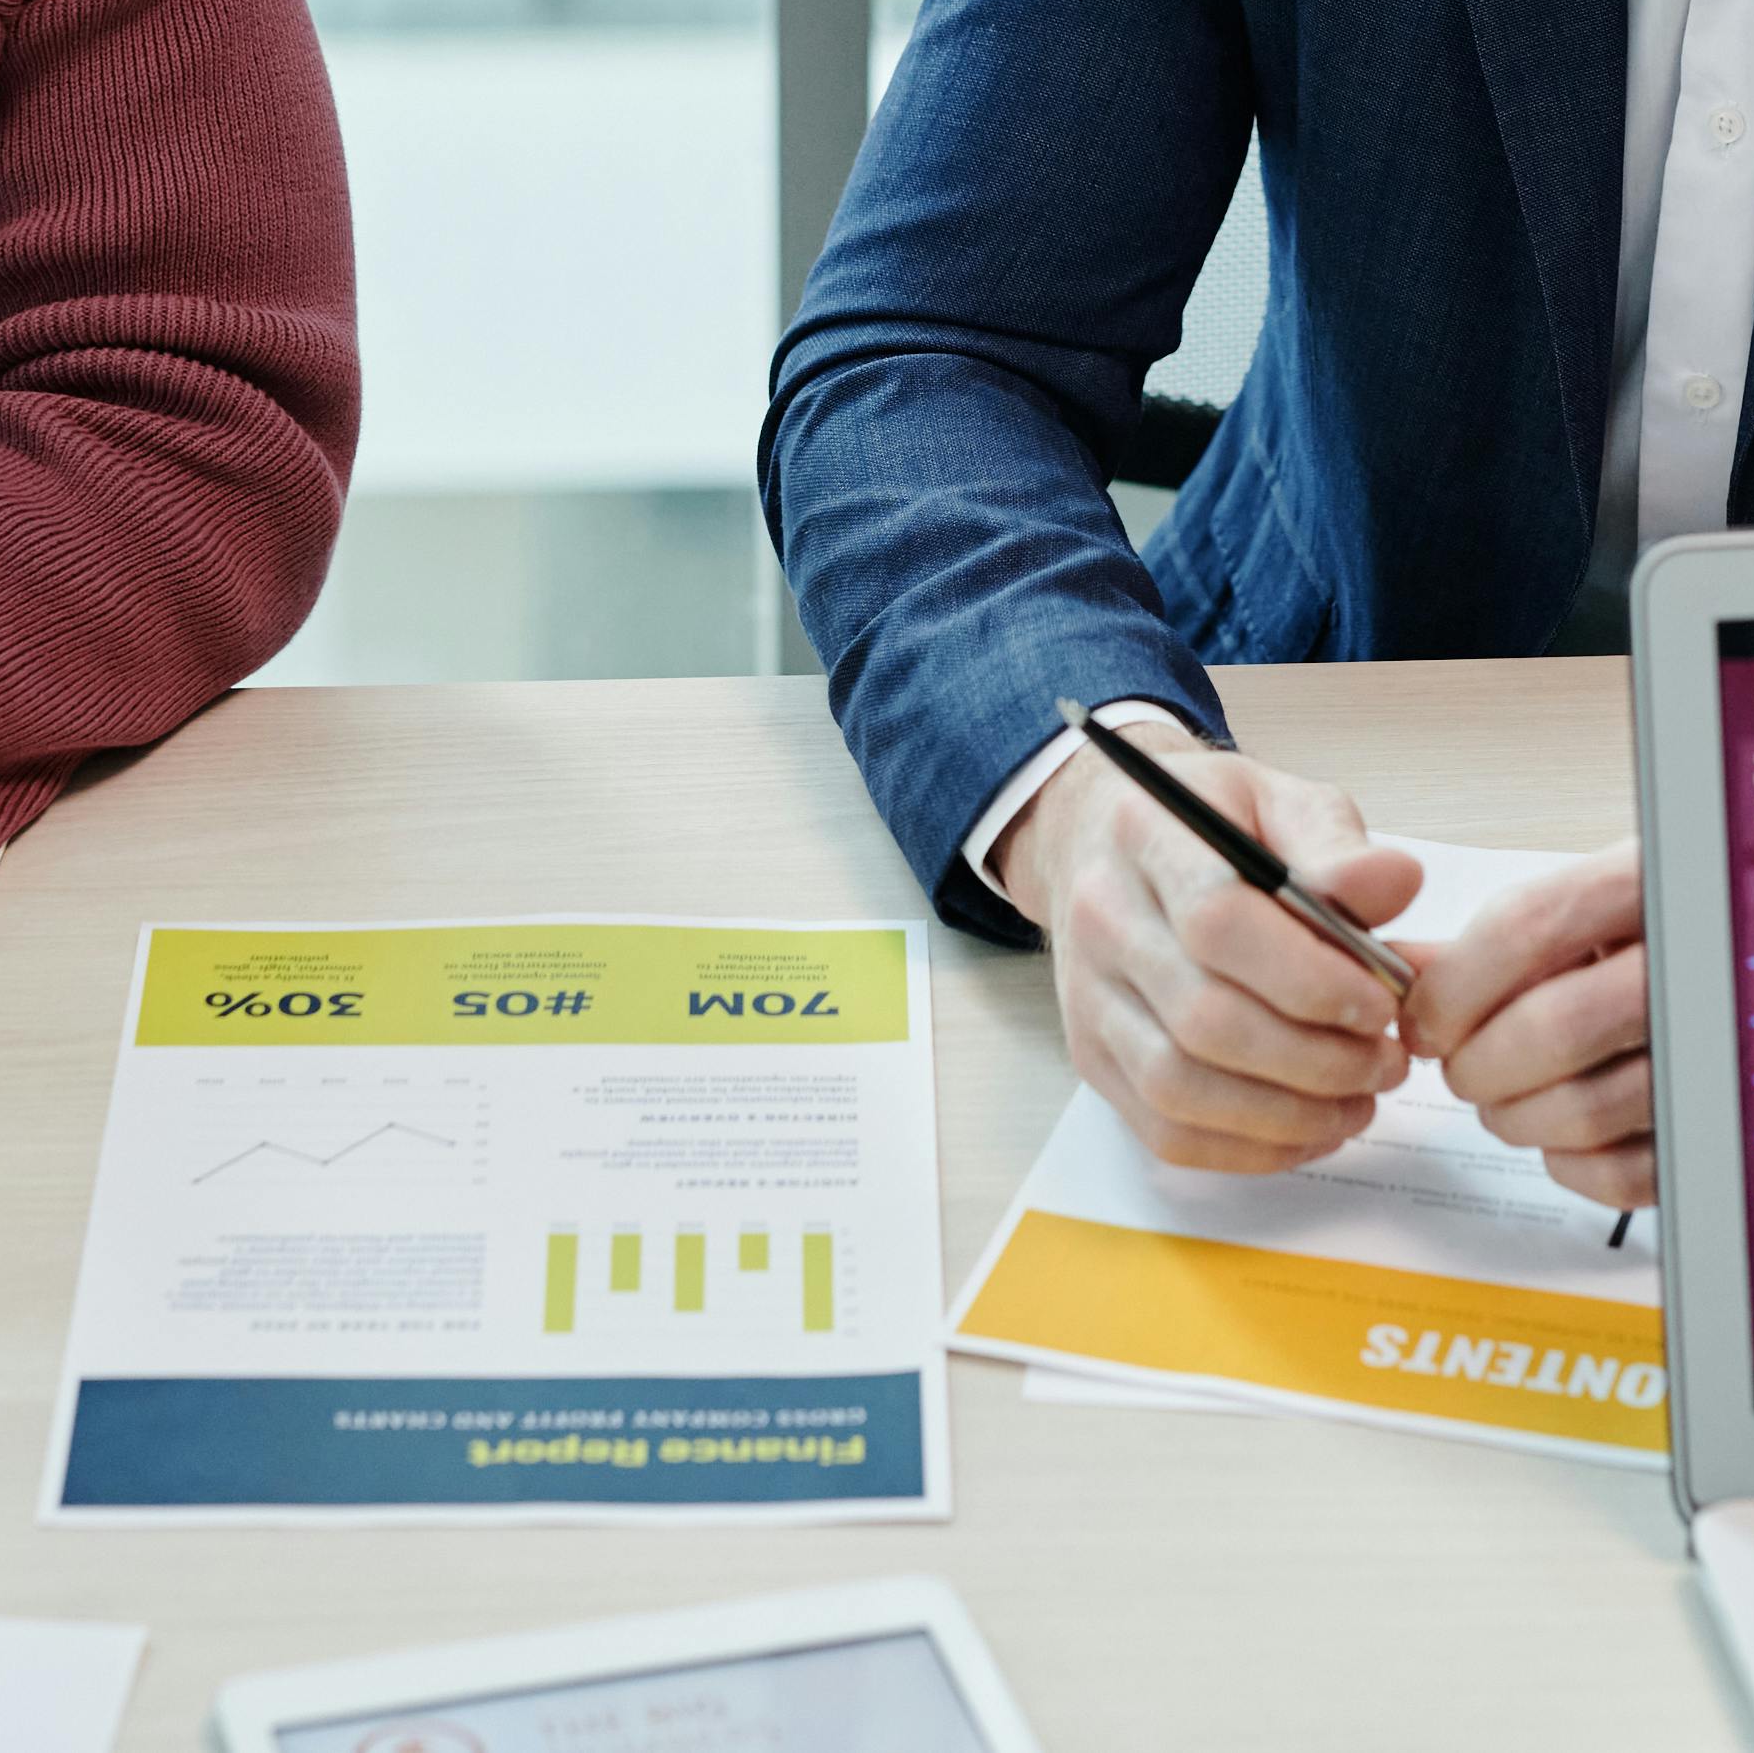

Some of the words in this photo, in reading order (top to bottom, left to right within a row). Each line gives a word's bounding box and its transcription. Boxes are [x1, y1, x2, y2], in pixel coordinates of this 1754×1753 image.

[205, 990, 366, 1019] 30%
[454, 990, 594, 1017] #05
[688, 990, 841, 1017] 70M
[1360, 1323, 1667, 1410] ONTENTS
[452, 1409, 515, 1430] AND
[521, 1408, 624, 1429] PROFIT
[632, 1407, 770, 1429] COMPANY
[467, 1433, 650, 1468] Report
[657, 1435, 868, 1467] Finance
